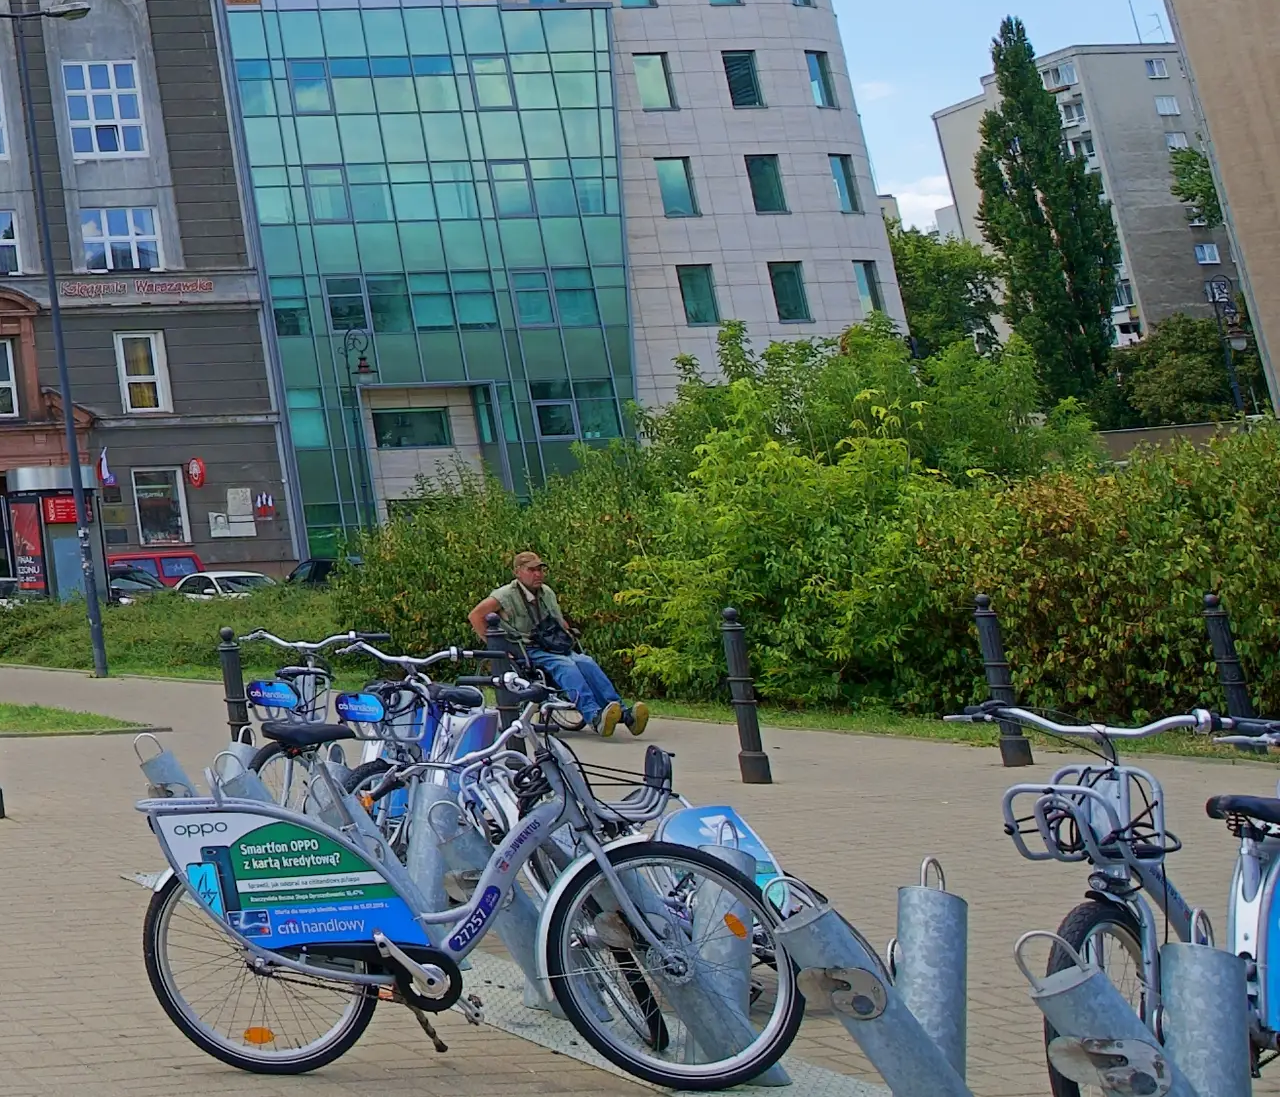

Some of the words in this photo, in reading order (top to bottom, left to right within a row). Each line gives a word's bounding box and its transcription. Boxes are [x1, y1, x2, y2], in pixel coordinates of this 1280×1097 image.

[135, 279, 213, 294] Warszawska
[174, 821, 228, 837] oppo
[240, 840, 288, 855] Smartfon
[290, 839, 319, 852] OPPO
[243, 860, 250, 870] z
[252, 856, 280, 871] kartą
[282, 852, 340, 869] kredytową?
[278, 920, 299, 934] citi
[302, 919, 365, 933] handlowy
[454, 907, 487, 946] 27257
